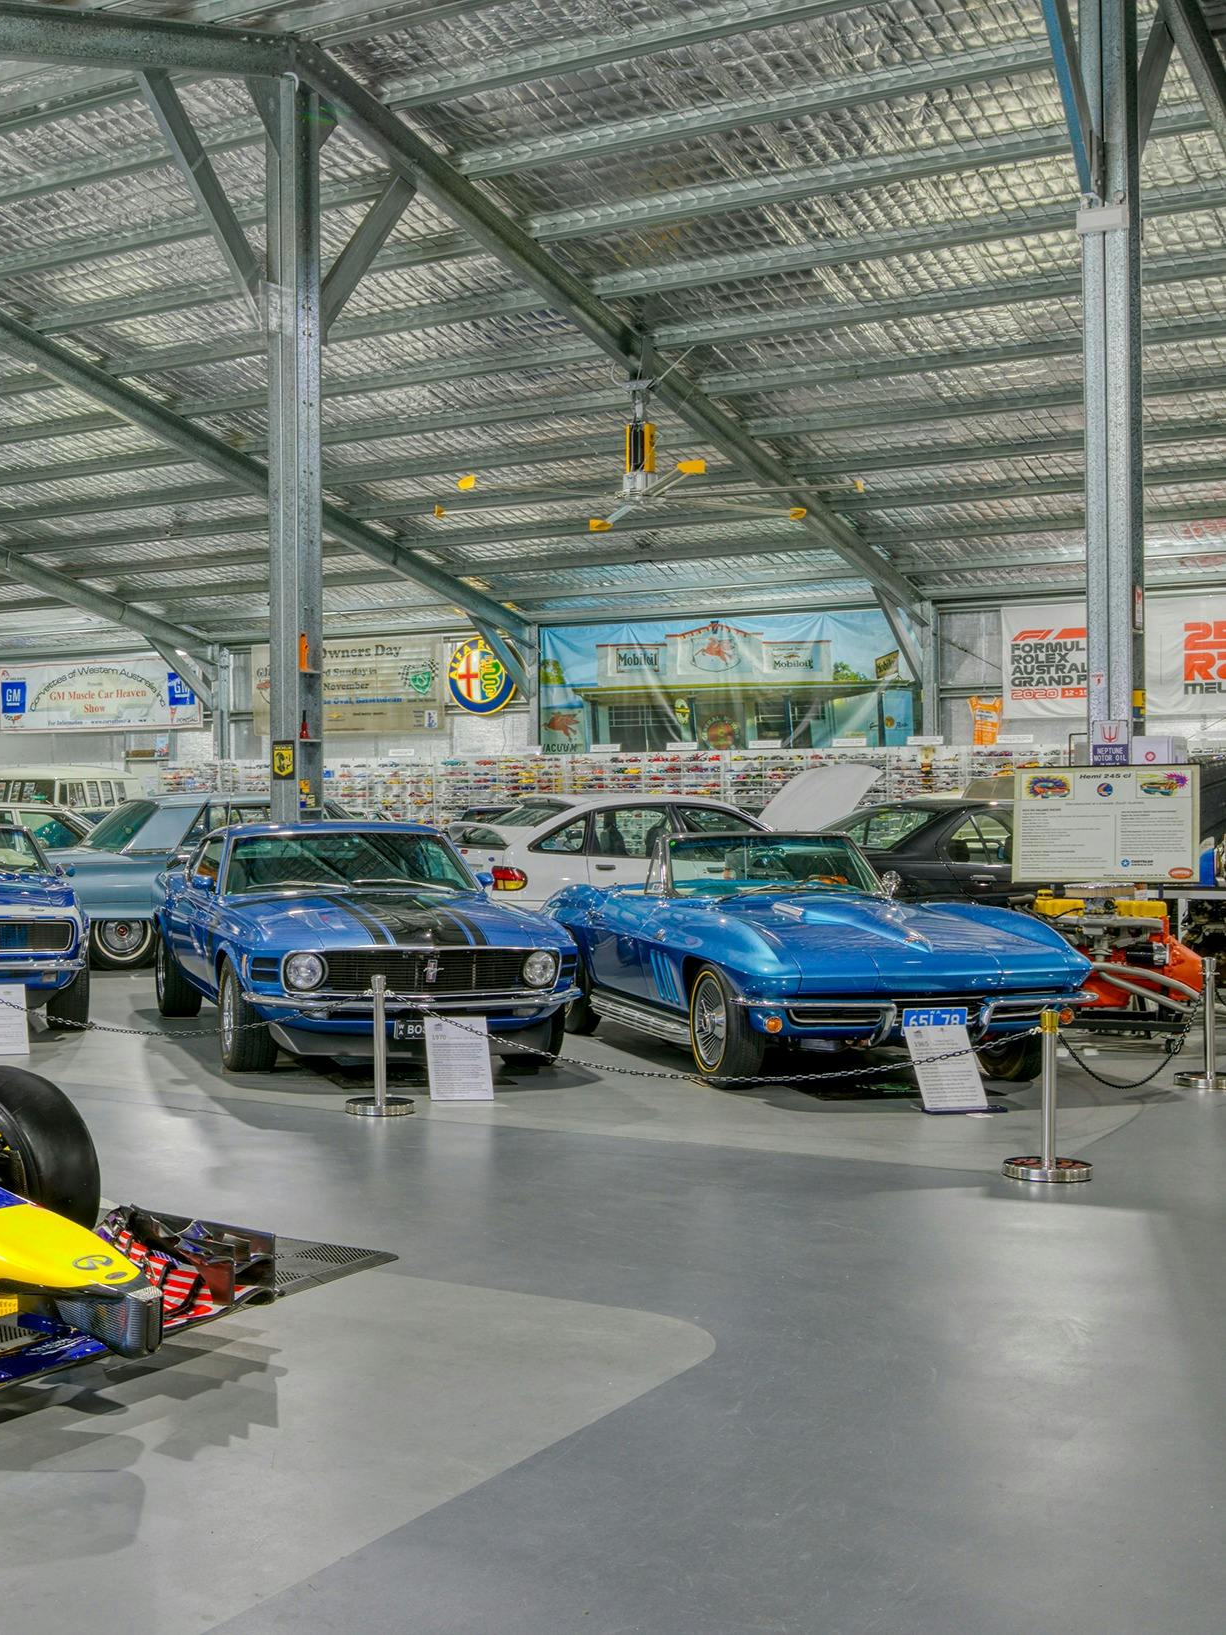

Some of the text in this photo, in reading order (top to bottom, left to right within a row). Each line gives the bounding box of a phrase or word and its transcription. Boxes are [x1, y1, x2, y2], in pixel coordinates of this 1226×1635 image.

[374, 643, 403, 657] Day
[1010, 639, 1086, 654] FORMUL
[618, 649, 659, 667] Mobiloil
[774, 659, 813, 669] Mobiloil
[1010, 652, 1070, 665] ROLEX
[333, 667, 368, 678] Sunday
[369, 667, 378, 675] in
[1010, 663, 1087, 676] AUSTRAL
[323, 682, 370, 691] November
[1010, 675, 1067, 688] GRAND
[30, 673, 67, 712] Corvettes
[67, 670, 76, 680] of
[77, 666, 119, 676] Western
[119, 668, 157, 694] Australia
[49, 689, 147, 701] GM Muscle Car Heaven
[1010, 688, 1059, 700] 2020
[1184, 682, 1226, 695] MEL
[6, 688, 21, 704] GM
[83, 703, 106, 714] Show
[1096, 747, 1124, 755] NEPTUNE
